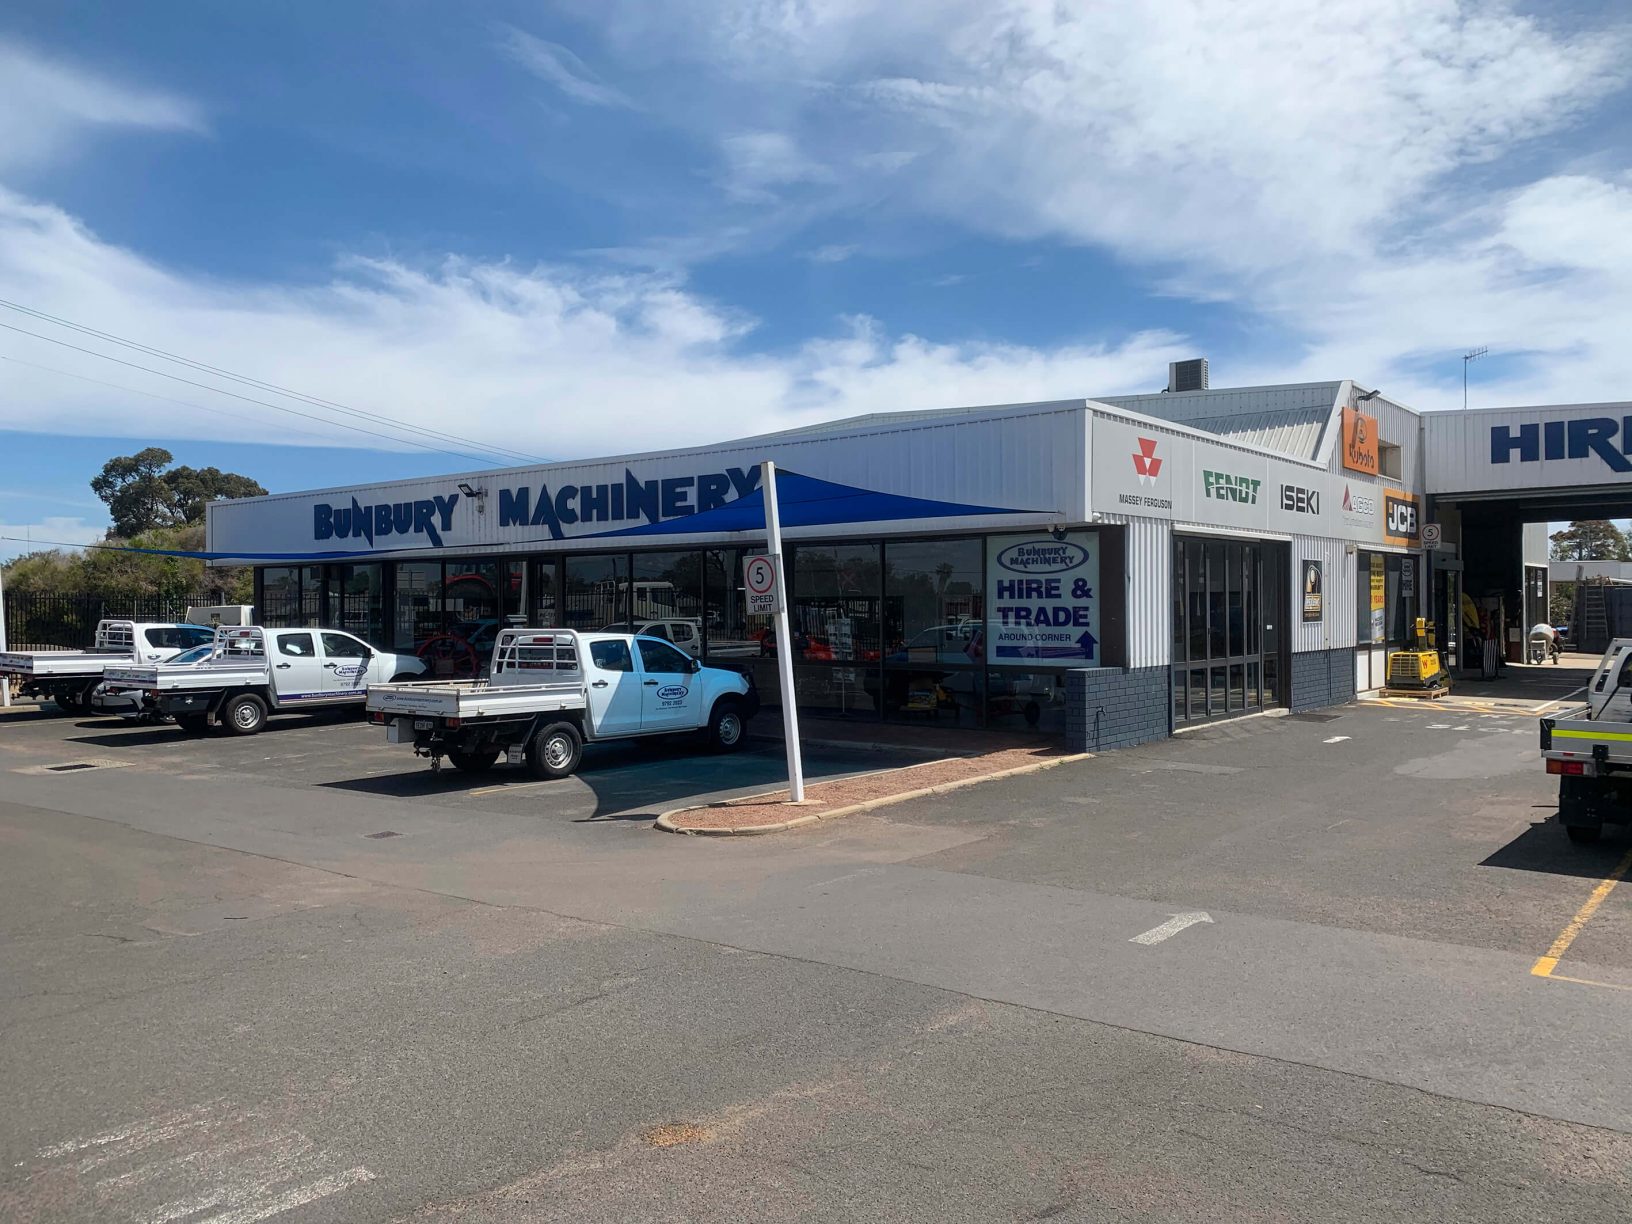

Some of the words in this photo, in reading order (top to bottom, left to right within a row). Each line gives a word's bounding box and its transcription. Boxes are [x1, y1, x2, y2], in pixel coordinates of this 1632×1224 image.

[1490, 416, 1632, 473] HIR
[1202, 470, 1261, 505] FENDT
[314, 494, 459, 549] BUNBURY
[498, 465, 762, 540] MACHINERY
[1118, 494, 1143, 506] MASSEY
[1143, 496, 1172, 510] FERGUSON
[1280, 484, 1320, 515] ISEKI
[1388, 502, 1417, 533] JCB
[1427, 528, 1434, 537] 5
[1017, 545, 1068, 558] BUNBURY
[1009, 556, 1075, 569] MACHINERY
[755, 566, 764, 584] 5
[997, 578, 1062, 600] HIRE
[1071, 577, 1094, 599] &
[750, 595, 774, 604] SPEED
[753, 603, 773, 612] LIMIT
[996, 606, 1090, 627] TRADE
[998, 633, 1033, 641] AROUND
[1035, 633, 1071, 641] CORNER
